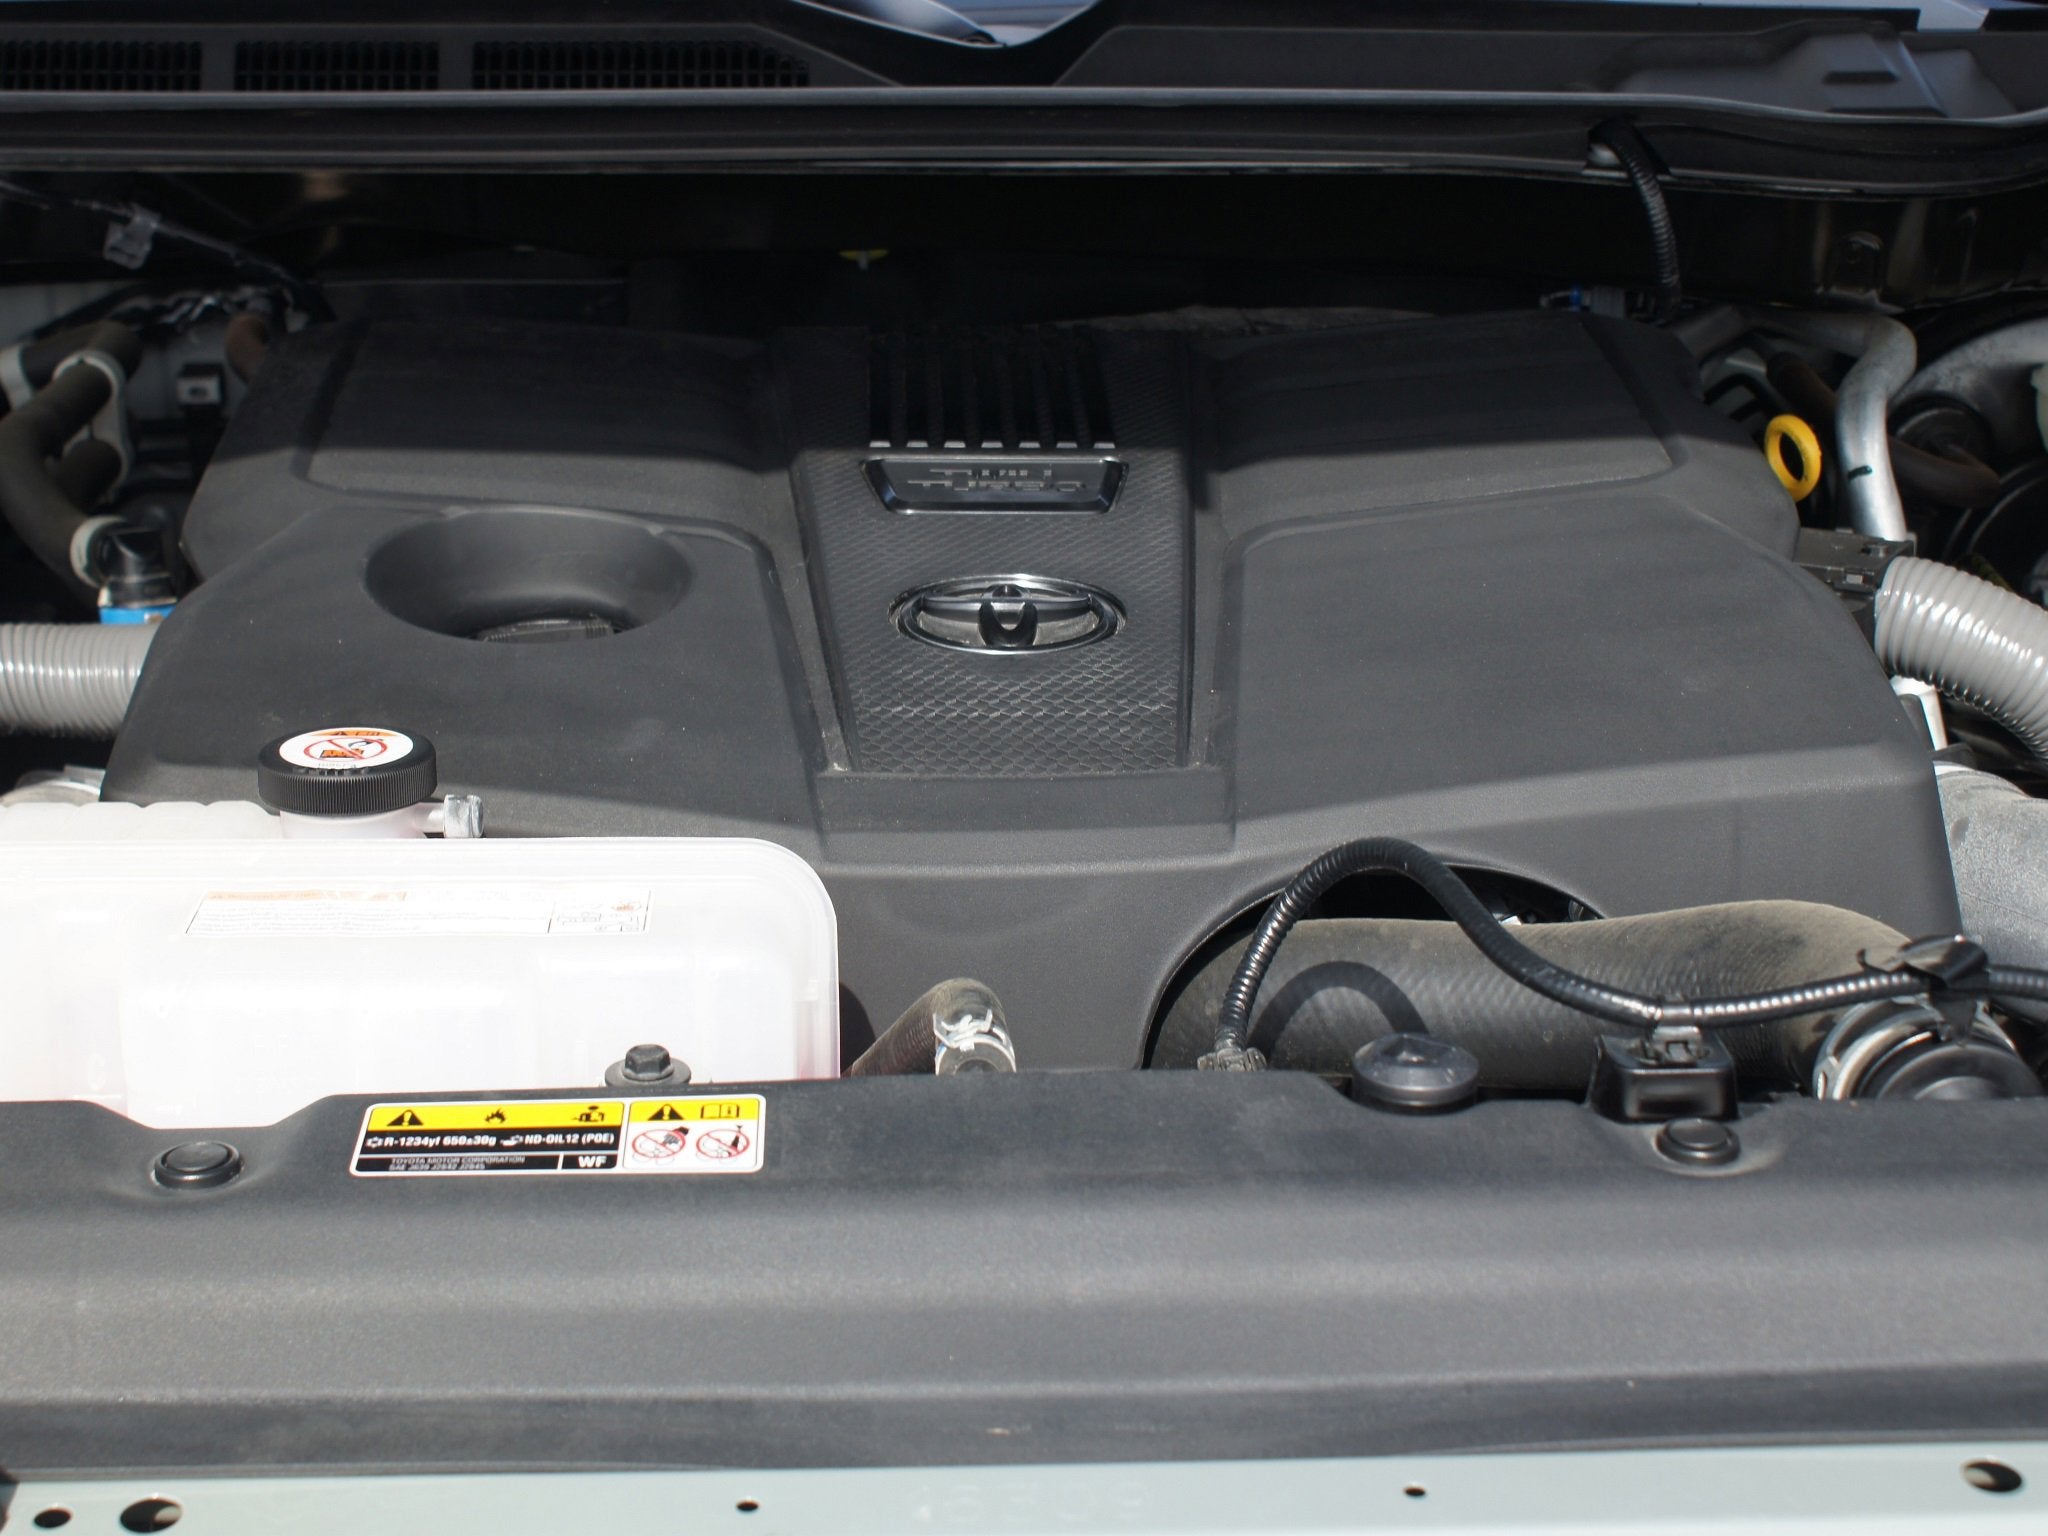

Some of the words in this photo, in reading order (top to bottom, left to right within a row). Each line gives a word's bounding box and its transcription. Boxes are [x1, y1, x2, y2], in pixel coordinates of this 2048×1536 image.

[383, 1136, 440, 1148] R-1234yf
[581, 1132, 615, 1146] (POE)
[427, 1156, 460, 1164] MOTOR
[461, 1155, 526, 1164] CORPORATION
[578, 1155, 607, 1168] WF
